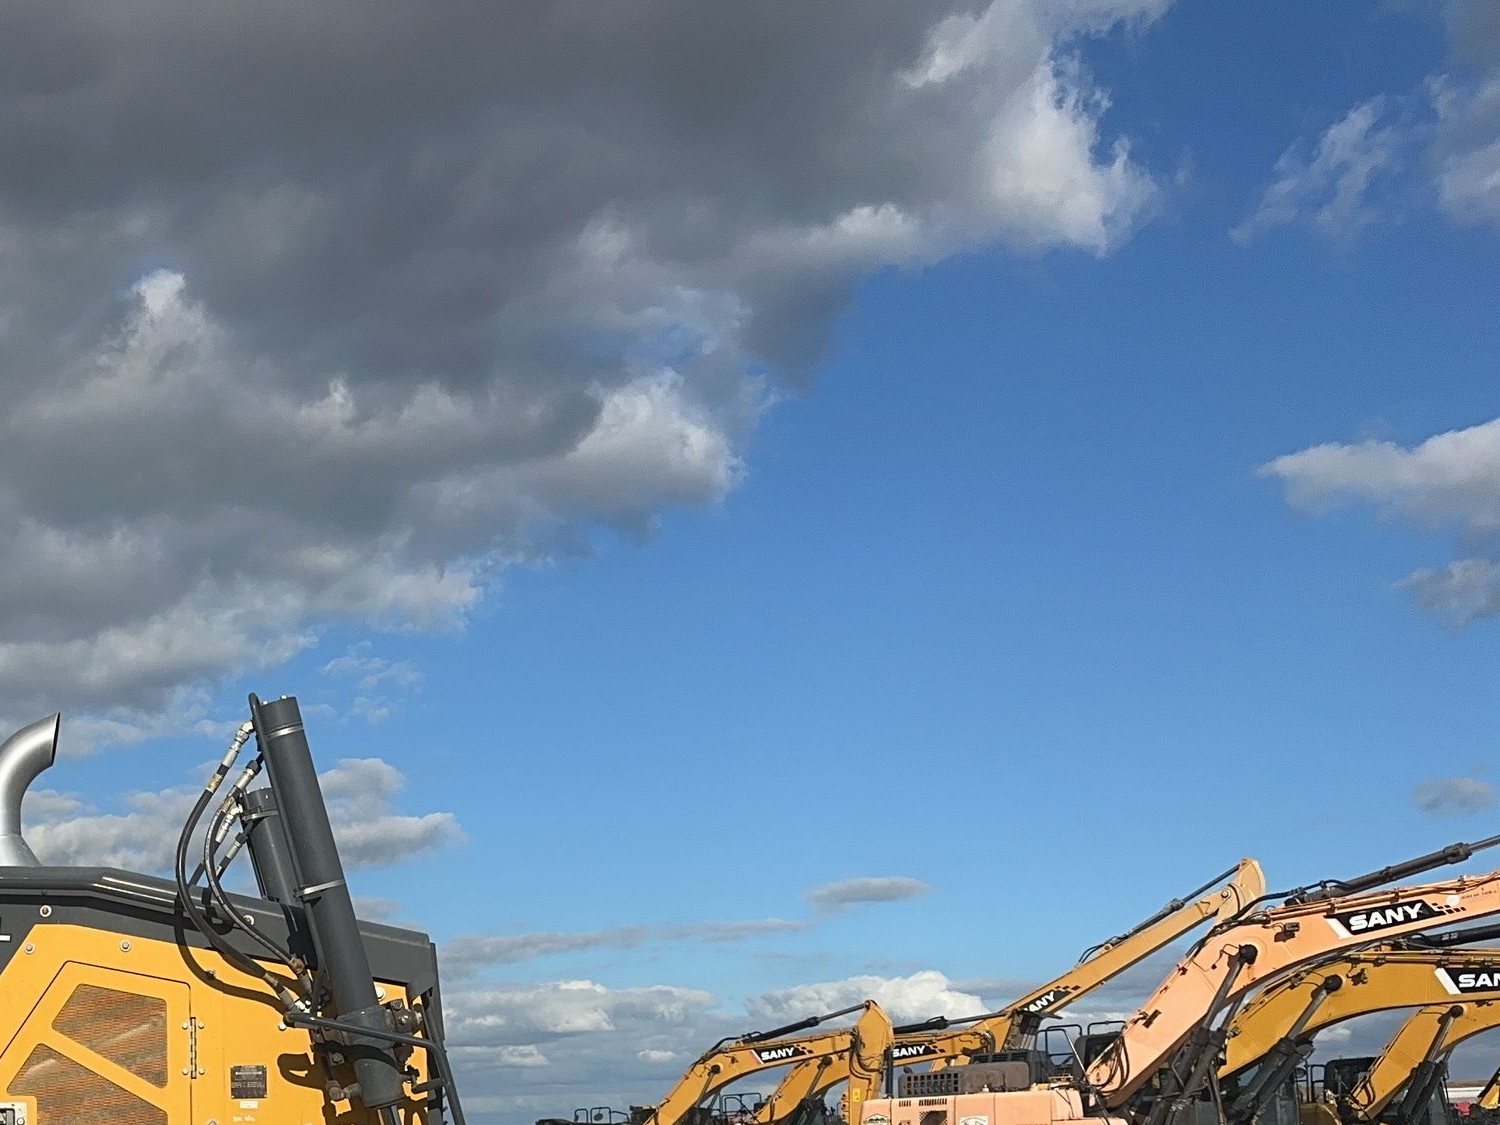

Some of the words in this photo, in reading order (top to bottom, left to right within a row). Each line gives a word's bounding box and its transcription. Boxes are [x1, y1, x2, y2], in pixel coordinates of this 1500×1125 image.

[1349, 903, 1422, 931] SANY
[1023, 991, 1055, 1012] ANY
[761, 1047, 795, 1060] SANY
[892, 1045, 926, 1058] SANY
